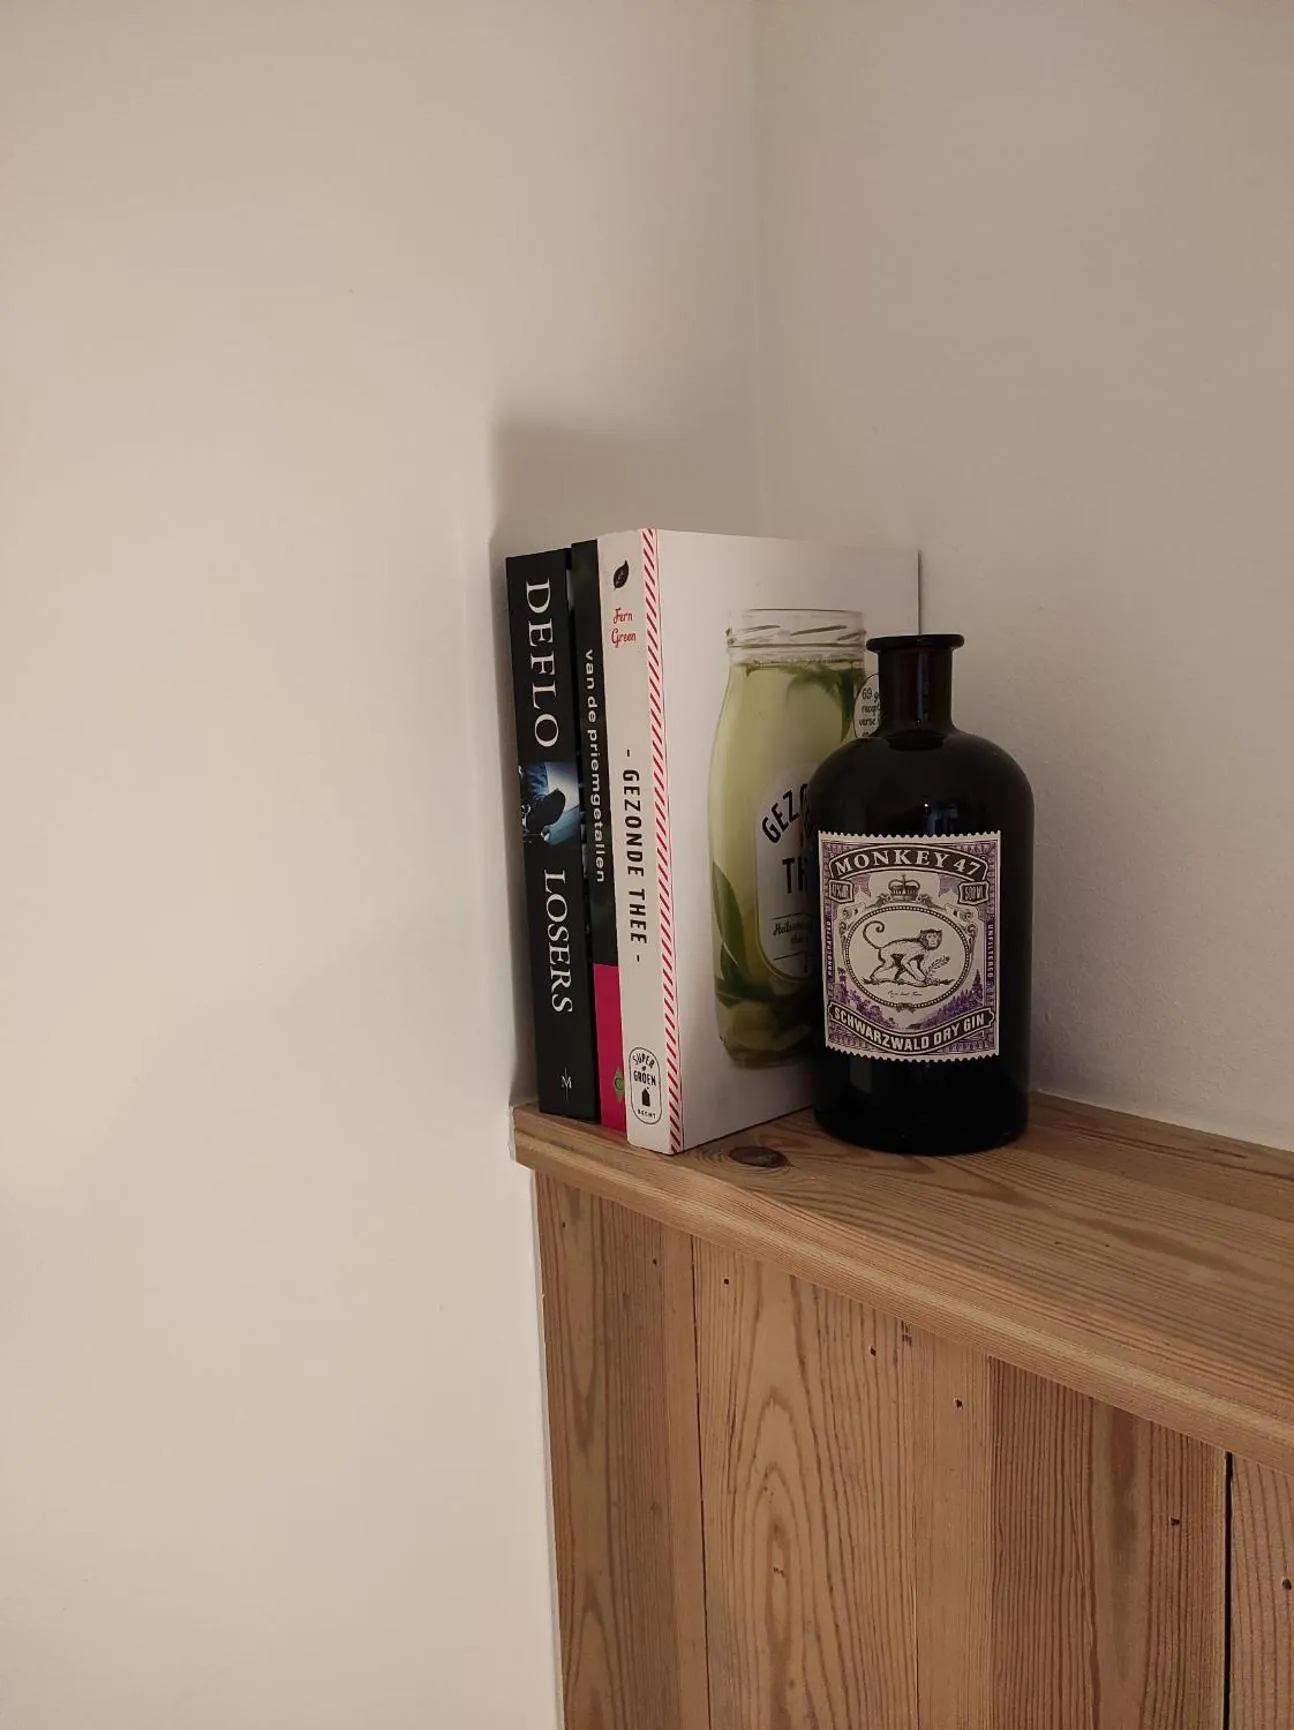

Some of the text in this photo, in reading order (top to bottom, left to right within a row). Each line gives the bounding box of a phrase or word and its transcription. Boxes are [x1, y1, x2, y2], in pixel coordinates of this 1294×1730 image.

[613, 607, 633, 624] Fern
[611, 628, 637, 648] Green
[526, 577, 559, 747] DEFLO
[585, 649, 605, 882] van de priemgetallen
[623, 769, 648, 944] GEZONDE THEE
[834, 849, 981, 876] MONKEY 47
[544, 870, 573, 1013] LOSERS
[834, 1007, 985, 1051] SCHWARZWALD DRY GIN
[632, 1052, 655, 1069] SUPER
[633, 1069, 657, 1086] GROEN
